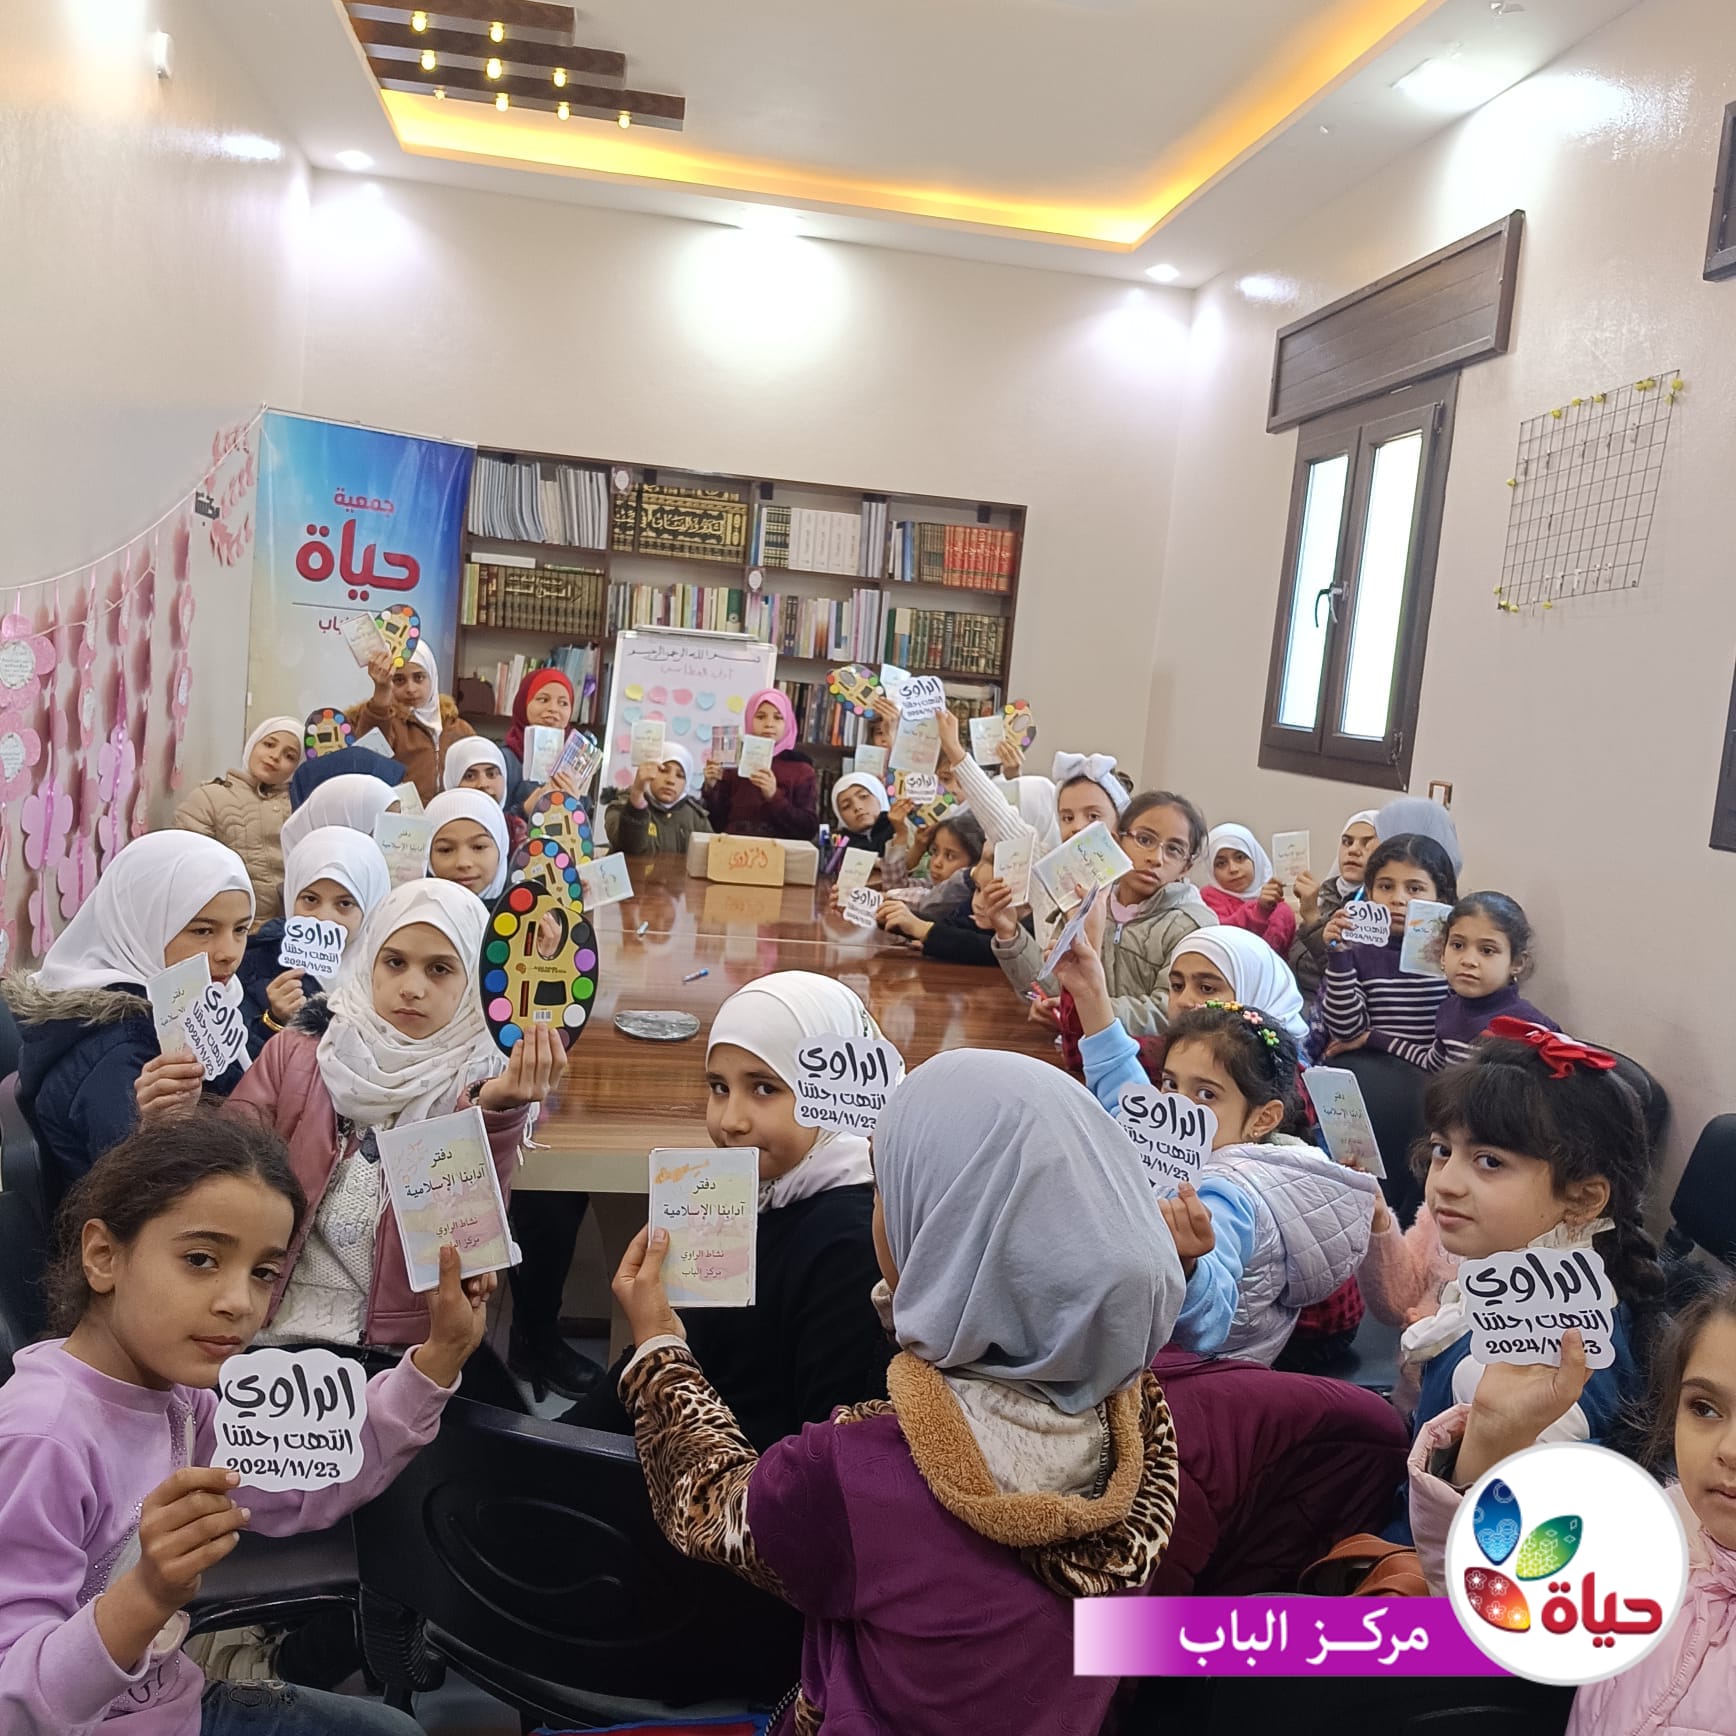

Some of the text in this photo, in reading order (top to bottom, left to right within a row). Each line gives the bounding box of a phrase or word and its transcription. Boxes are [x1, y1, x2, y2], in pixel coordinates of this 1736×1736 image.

[334, 487, 394, 517] جمعية
[295, 518, 421, 602] حياة
[900, 678, 941, 700] الراوي
[850, 888, 881, 908] الراوي
[286, 922, 342, 949] الراوي
[283, 955, 333, 974] 2024/11/23
[284, 942, 340, 965] انتهت رحلتنا
[202, 985, 244, 1059] الراوي
[184, 1017, 216, 1077] 2024/11/23
[798, 1042, 889, 1087] الراوي
[797, 1079, 887, 1110] انتهت رحلتنا
[800, 1105, 877, 1130] 2024/11/23
[1121, 1095, 1206, 1147] الراوي
[430, 1148, 453, 1169] دفتر
[1140, 1152, 1190, 1183] 4/11/23
[1156, 1141, 1201, 1170] انتهت
[404, 1163, 486, 1199] آدابنا الإسلامية
[692, 1178, 716, 1194] دفتر
[663, 1201, 746, 1220] آدابنا الإسلامية
[436, 1217, 479, 1237] نشاط الراوي
[681, 1250, 725, 1260] نشاط الراوي
[681, 1267, 722, 1279] مركز الباب
[1465, 1251, 1602, 1307] الراوي
[1472, 1309, 1609, 1333] انتهت رحلتنا
[224, 1363, 356, 1422] الراوي
[222, 1422, 354, 1455] انتهت رحلتنا
[226, 1457, 341, 1479] 2024/11/23
